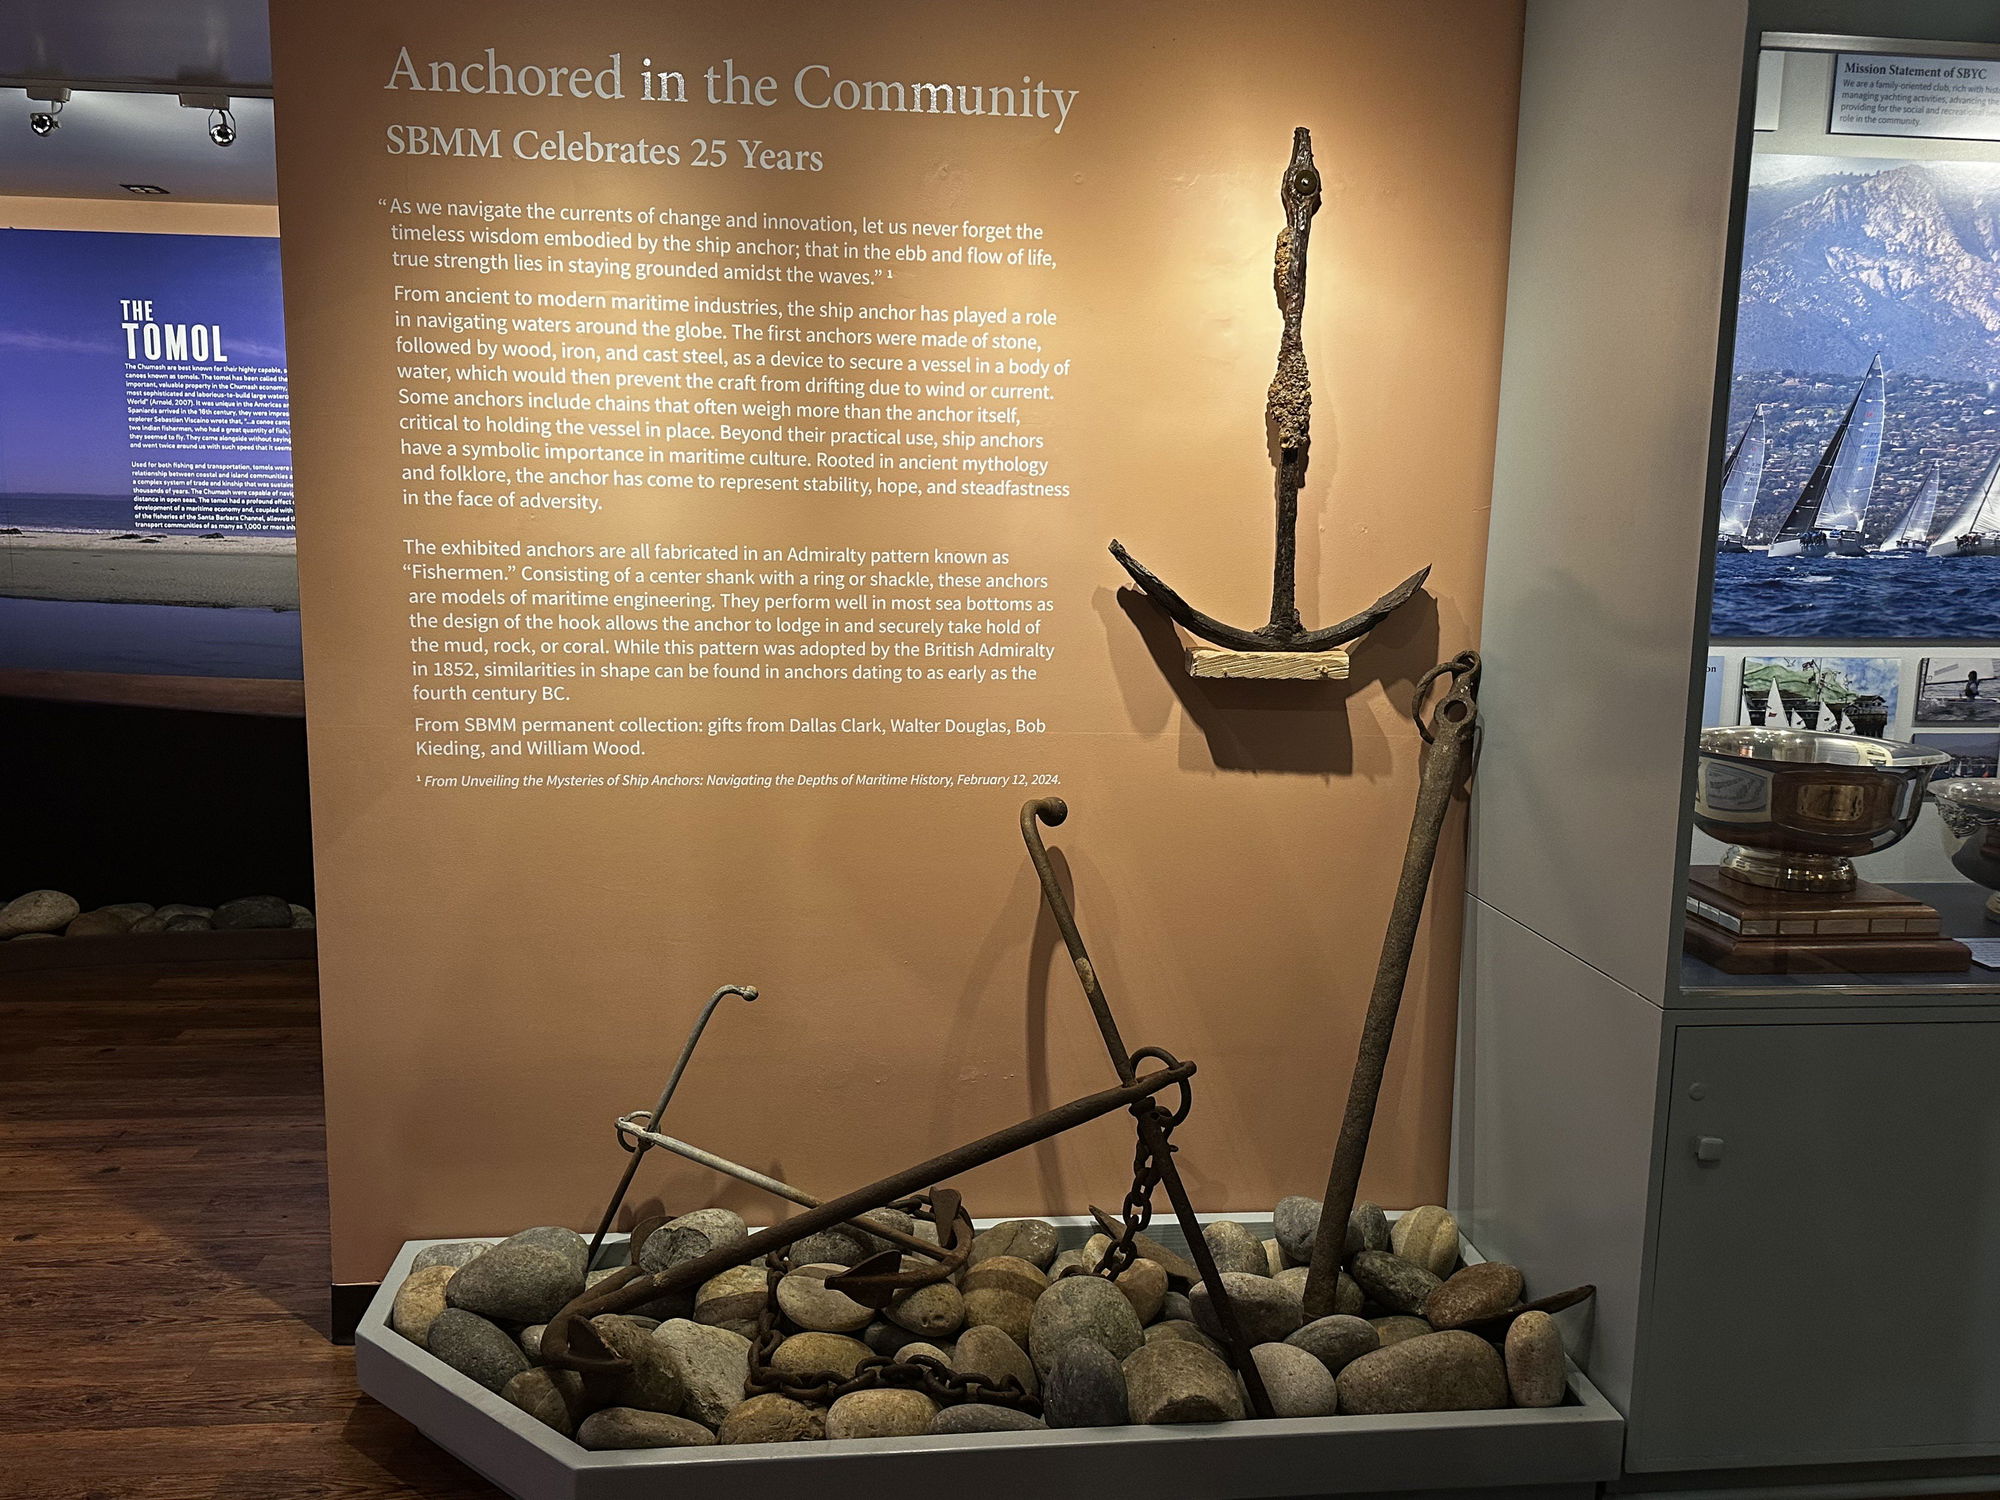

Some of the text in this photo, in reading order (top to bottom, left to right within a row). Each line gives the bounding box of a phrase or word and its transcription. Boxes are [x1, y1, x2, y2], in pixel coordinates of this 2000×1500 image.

[1844, 63, 1988, 80] Mission Statement of SBYC
[384, 46, 1080, 135] Anchored in the Community
[1876, 80, 1932, 91] family-oriented
[1933, 82, 1951, 93] club,
[1952, 84, 1966, 92] rich
[1842, 92, 1879, 101] managing
[1880, 93, 1911, 103] yachting
[1913, 94, 1948, 104] activities,
[1949, 96, 1986, 106] advancing
[1841, 104, 1876, 113] providing
[1877, 104, 1889, 112] for
[1890, 105, 1902, 113] the
[1903, 106, 1924, 114] social
[1856, 115, 1862, 123] in
[1878, 116, 1921, 127] community.
[387, 124, 824, 172] SBMM Celebrates 25 Years
[416, 202, 442, 216] we
[447, 200, 522, 222] navigate
[526, 202, 556, 220] the
[560, 208, 633, 223] currents
[637, 207, 656, 224] of
[659, 208, 721, 231] change
[726, 212, 758, 229] and
[763, 212, 858, 237] innovation,
[863, 217, 884, 234] let
[889, 222, 907, 235] us
[912, 223, 959, 237] never
[962, 220, 1012, 243] forget
[1016, 223, 1043, 240] the
[391, 223, 1057, 270] timeless wisdom embodied by the ship anchor; that in the ebb and flow of life,
[392, 251, 429, 268] true
[434, 253, 509, 274] strength
[514, 254, 543, 272] lies
[548, 256, 564, 272] in
[568, 258, 632, 280] staying
[636, 261, 718, 280] grounded
[724, 264, 782, 282] amidst
[786, 265, 814, 283] the
[818, 269, 883, 285] waves.”
[120, 299, 154, 321] THE
[121, 322, 228, 362] TOMOL
[238, 366, 257, 374] highly
[258, 366, 282, 374] capable,
[126, 381, 157, 389] important,
[185, 382, 210, 390] property
[173, 462, 193, 470] fishing
[207, 463, 251, 471] transportation,
[134, 504, 172, 512] development
[415, 717, 1046, 737] From SBMM permanent collection: gifts from Dallas Clark, Walter Douglas, Bob
[416, 740, 645, 760] Kieding, and William Wood.
[424, 775, 458, 787] From
[461, 774, 520, 790] Unveiling
[523, 774, 544, 787] the
[546, 774, 605, 789] Mysteries
[607, 774, 620, 787] of
[621, 774, 650, 789] Ship
[651, 774, 704, 786] Anchors:
[706, 774, 773, 789] Navigating
[775, 773, 797, 786] the
[797, 773, 839, 788] Depths
[841, 773, 855, 786] of
[855, 773, 908, 786] Maritime
[910, 774, 954, 788] History,
[957, 774, 1010, 788] February
[1012, 774, 1028, 787] 12,
[1031, 774, 1061, 785] 2024.
